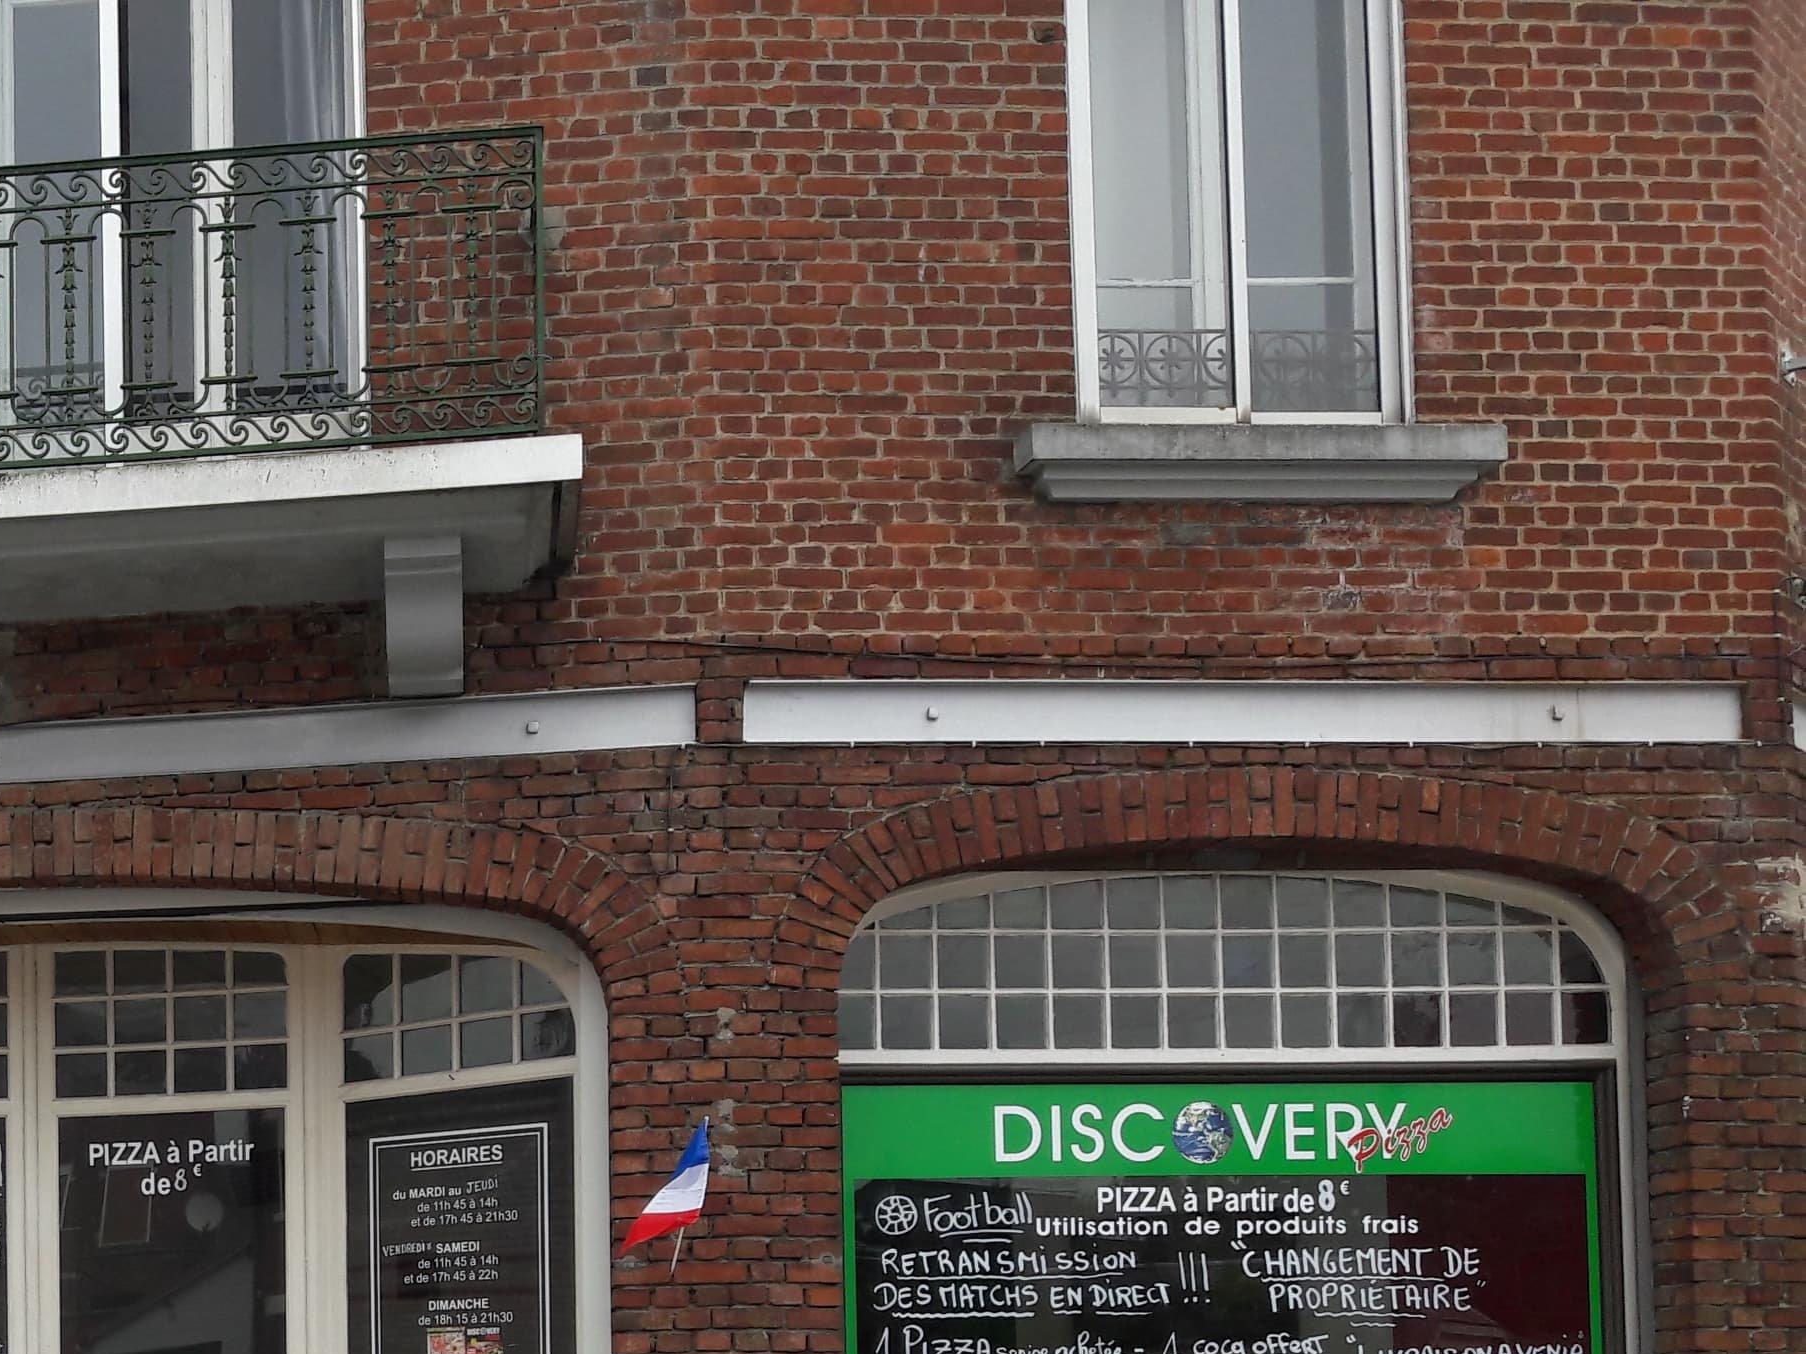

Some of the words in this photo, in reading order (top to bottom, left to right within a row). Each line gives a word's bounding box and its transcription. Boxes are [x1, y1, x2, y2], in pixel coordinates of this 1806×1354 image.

[1347, 1107, 1453, 1173] Pizza
[88, 1141, 160, 1167] PIZZA
[166, 1140, 180, 1163] à
[188, 1139, 255, 1163] Partir
[410, 1144, 503, 1168] HORAIRES
[140, 1172, 171, 1195] de
[393, 1189, 406, 1200] du
[409, 1187, 445, 1199] MARDI
[448, 1187, 462, 1196] au
[417, 1202, 430, 1213] de
[433, 1200, 451, 1211] 11h
[453, 1199, 467, 1210] 45
[479, 1197, 498, 1208] 14h
[1097, 1186, 1177, 1213] PIZZA
[1183, 1185, 1197, 1213] à
[1206, 1185, 1278, 1213] Partir
[1282, 1186, 1315, 1213] de
[410, 1217, 421, 1227] et
[423, 1215, 436, 1226] de
[439, 1214, 457, 1225] 17h
[460, 1213, 473, 1224] 45
[485, 1210, 518, 1222] 21h30
[923, 1191, 1033, 1233] Football
[1035, 1215, 1168, 1237] Utilisation
[1184, 1216, 1220, 1236] de
[1237, 1216, 1347, 1239] produits
[1362, 1215, 1419, 1234] frais
[436, 1241, 480, 1254] SAMEDI
[417, 1258, 431, 1269] de
[433, 1257, 451, 1268] 11h
[454, 1256, 467, 1267] 45
[480, 1254, 499, 1265] 14h
[1440, 1247, 1481, 1278] DE
[404, 1274, 413, 1284] et
[416, 1272, 429, 1283] de
[432, 1271, 450, 1282] 17h
[453, 1270, 466, 1281] 45
[478, 1268, 498, 1280] 22h
[428, 1298, 489, 1311] DIMANCHE
[873, 1282, 932, 1311] DES
[939, 1284, 1038, 1308] MATCHS
[1049, 1285, 1083, 1308] EN
[418, 1314, 431, 1326] de
[434, 1314, 452, 1325] 18h
[456, 1313, 468, 1324] 15
[480, 1311, 514, 1323] 21h30
